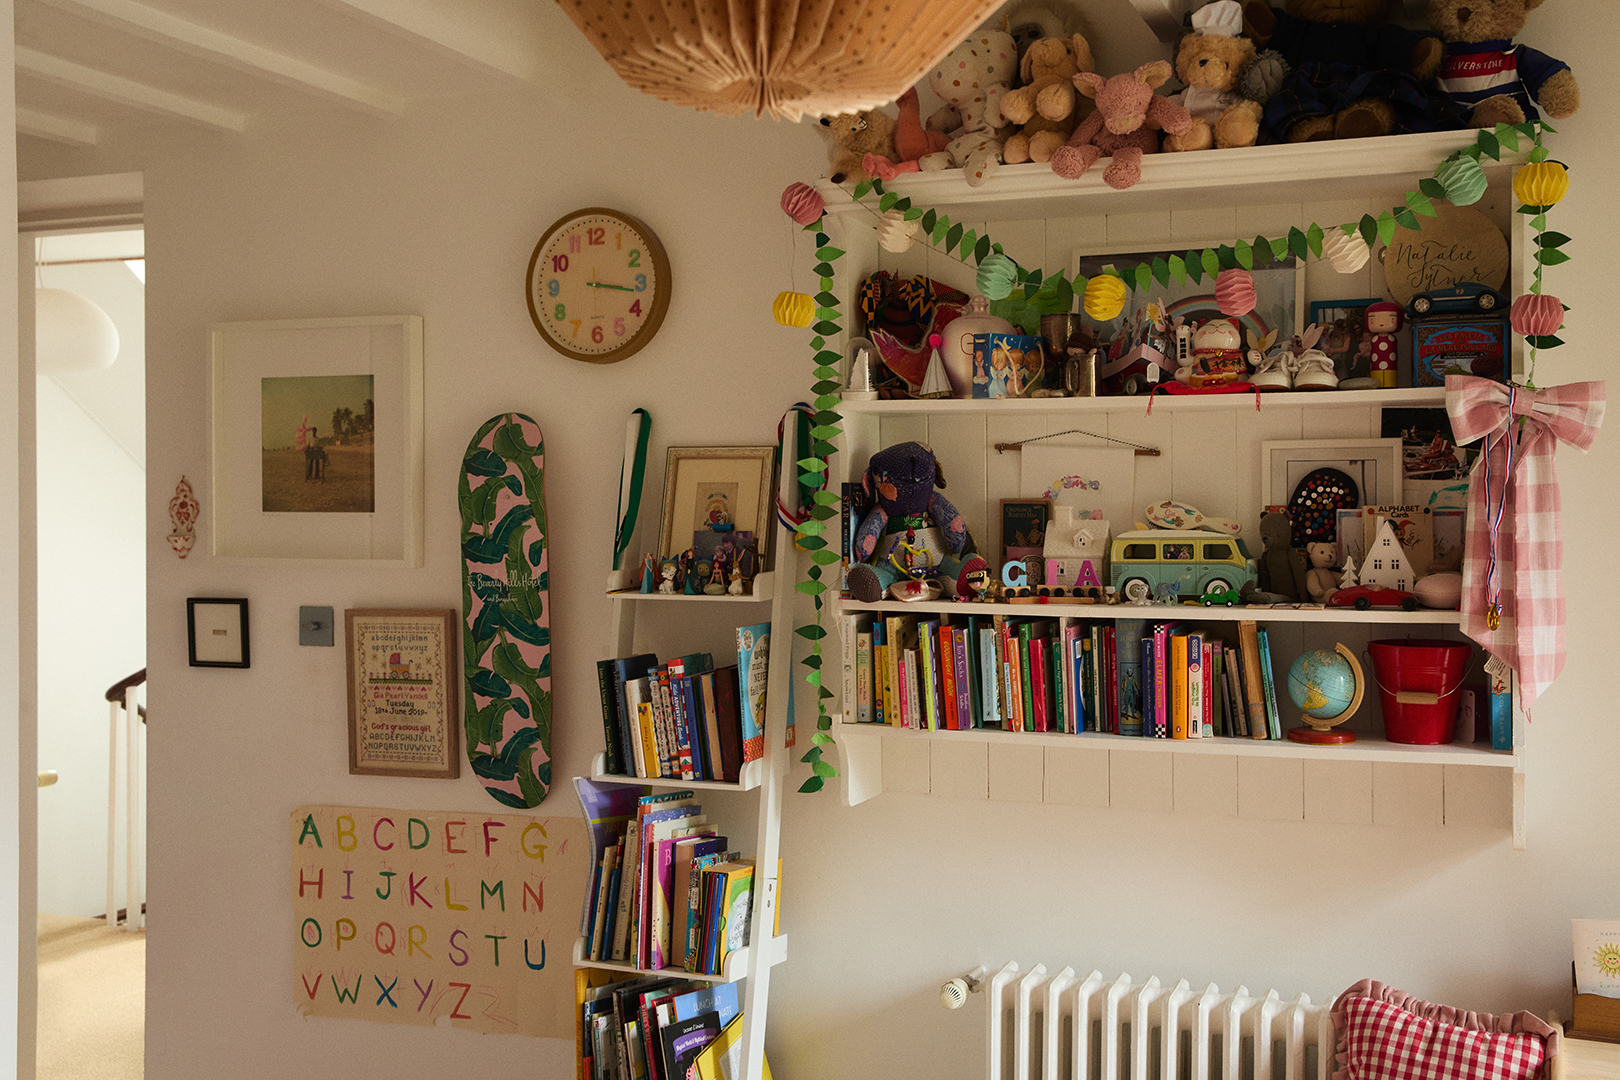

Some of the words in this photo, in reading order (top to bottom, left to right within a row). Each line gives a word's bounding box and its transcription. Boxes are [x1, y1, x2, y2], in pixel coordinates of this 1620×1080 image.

[569, 235, 581, 253] 11
[587, 228, 605, 245] 12
[615, 233, 621, 250] 1
[552, 254, 568, 273] 10
[628, 249, 641, 267] 2
[1396, 240, 1478, 269] Natalie
[548, 279, 560, 297] 9
[635, 274, 647, 292] 3
[555, 304, 566, 321] 8
[629, 299, 642, 317] 4
[570, 320, 582, 338] 7
[592, 326, 603, 344] 6
[614, 318, 625, 336] 5
[1440, 332, 1453, 341] LES
[1425, 346, 1436, 354] LA
[1461, 343, 1497, 352] POULARD
[943, 641, 952, 676] GOODNIGHT
[386, 700, 414, 708] Tuesday
[673, 696, 682, 726] ADVENTURE
[370, 733, 435, 742] ABCDEFGHIJKLM
[391, 724, 419, 734] gracious
[420, 724, 431, 734] gift
[368, 742, 437, 752] NOPQRSTUVWXYZ
[298, 814, 323, 848] A
[336, 815, 357, 852] B
[373, 817, 395, 851] C
[408, 818, 430, 850] D
[445, 822, 468, 854] E
[482, 822, 506, 857] F
[520, 822, 548, 863] G
[622, 865, 631, 884] Brambly
[299, 868, 323, 899] H
[341, 870, 355, 900] I
[376, 871, 397, 900] J
[408, 872, 433, 909] K
[444, 877, 469, 911] L
[480, 879, 505, 912] M
[522, 880, 543, 913] N
[301, 918, 322, 947] O
[336, 918, 357, 951] P
[375, 922, 396, 956] Q
[408, 925, 432, 959] R
[449, 929, 469, 966] S
[484, 934, 507, 967] T
[524, 939, 545, 970] U
[302, 973, 322, 1000] V
[331, 973, 362, 1004] W
[374, 974, 398, 1008] X
[414, 978, 434, 1012] Y
[448, 982, 472, 1019] Z
[693, 998, 713, 1012] LUNCH
[714, 996, 722, 1006] AT
